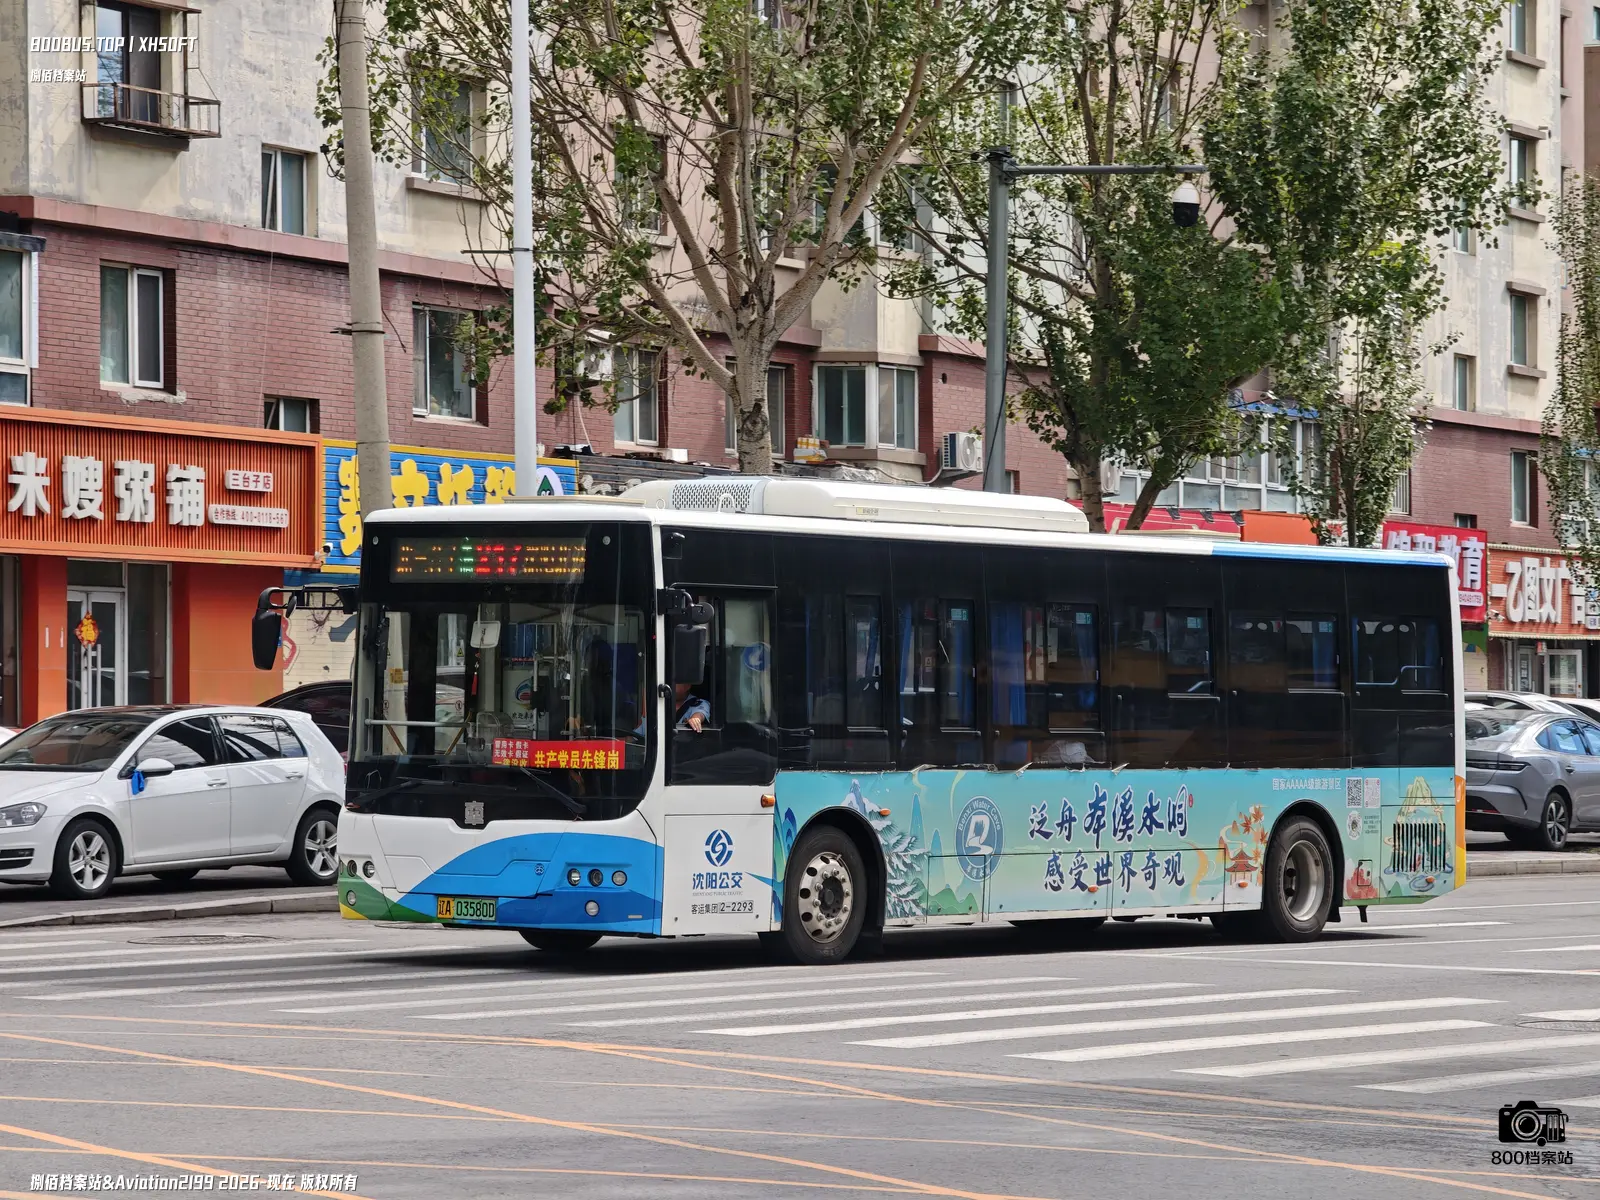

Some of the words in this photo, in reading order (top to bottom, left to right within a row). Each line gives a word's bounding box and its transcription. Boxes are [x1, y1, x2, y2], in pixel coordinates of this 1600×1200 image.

[7, 451, 206, 527] 米嫂粥铺
[231, 473, 271, 489] 三台子店
[535, 750, 620, 770] 共产党员先锋岗
[1272, 778, 1342, 791] 国家AAAAA级旅游景区
[972, 800, 990, 811] Water
[1043, 849, 1186, 893] 感受世界奇观
[692, 871, 743, 889] 沈阳公交
[691, 903, 718, 914] 客运集团
[720, 901, 754, 912] 2-2293
